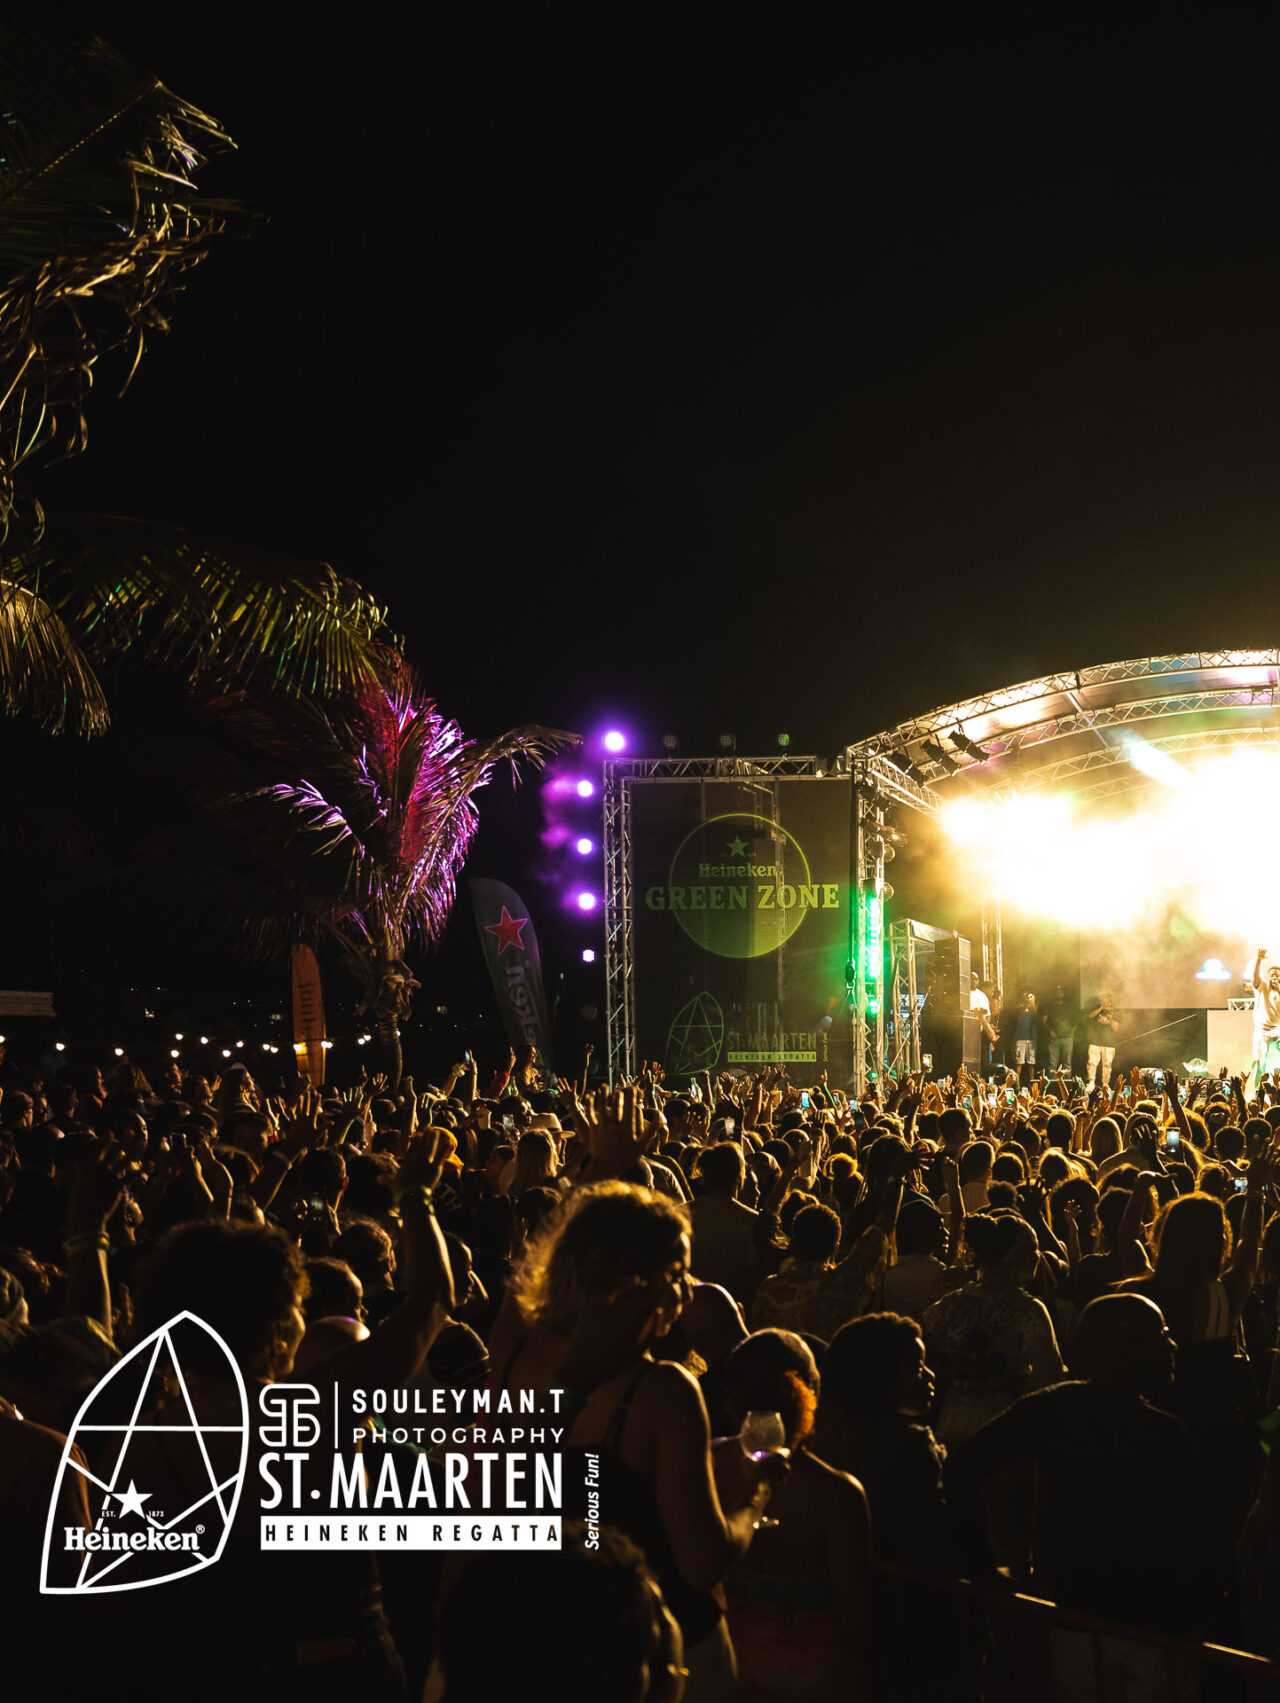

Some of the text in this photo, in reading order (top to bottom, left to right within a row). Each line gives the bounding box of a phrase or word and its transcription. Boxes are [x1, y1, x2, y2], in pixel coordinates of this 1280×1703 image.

[698, 862, 777, 878] Heineken
[646, 883, 840, 911] GREEN ZONE
